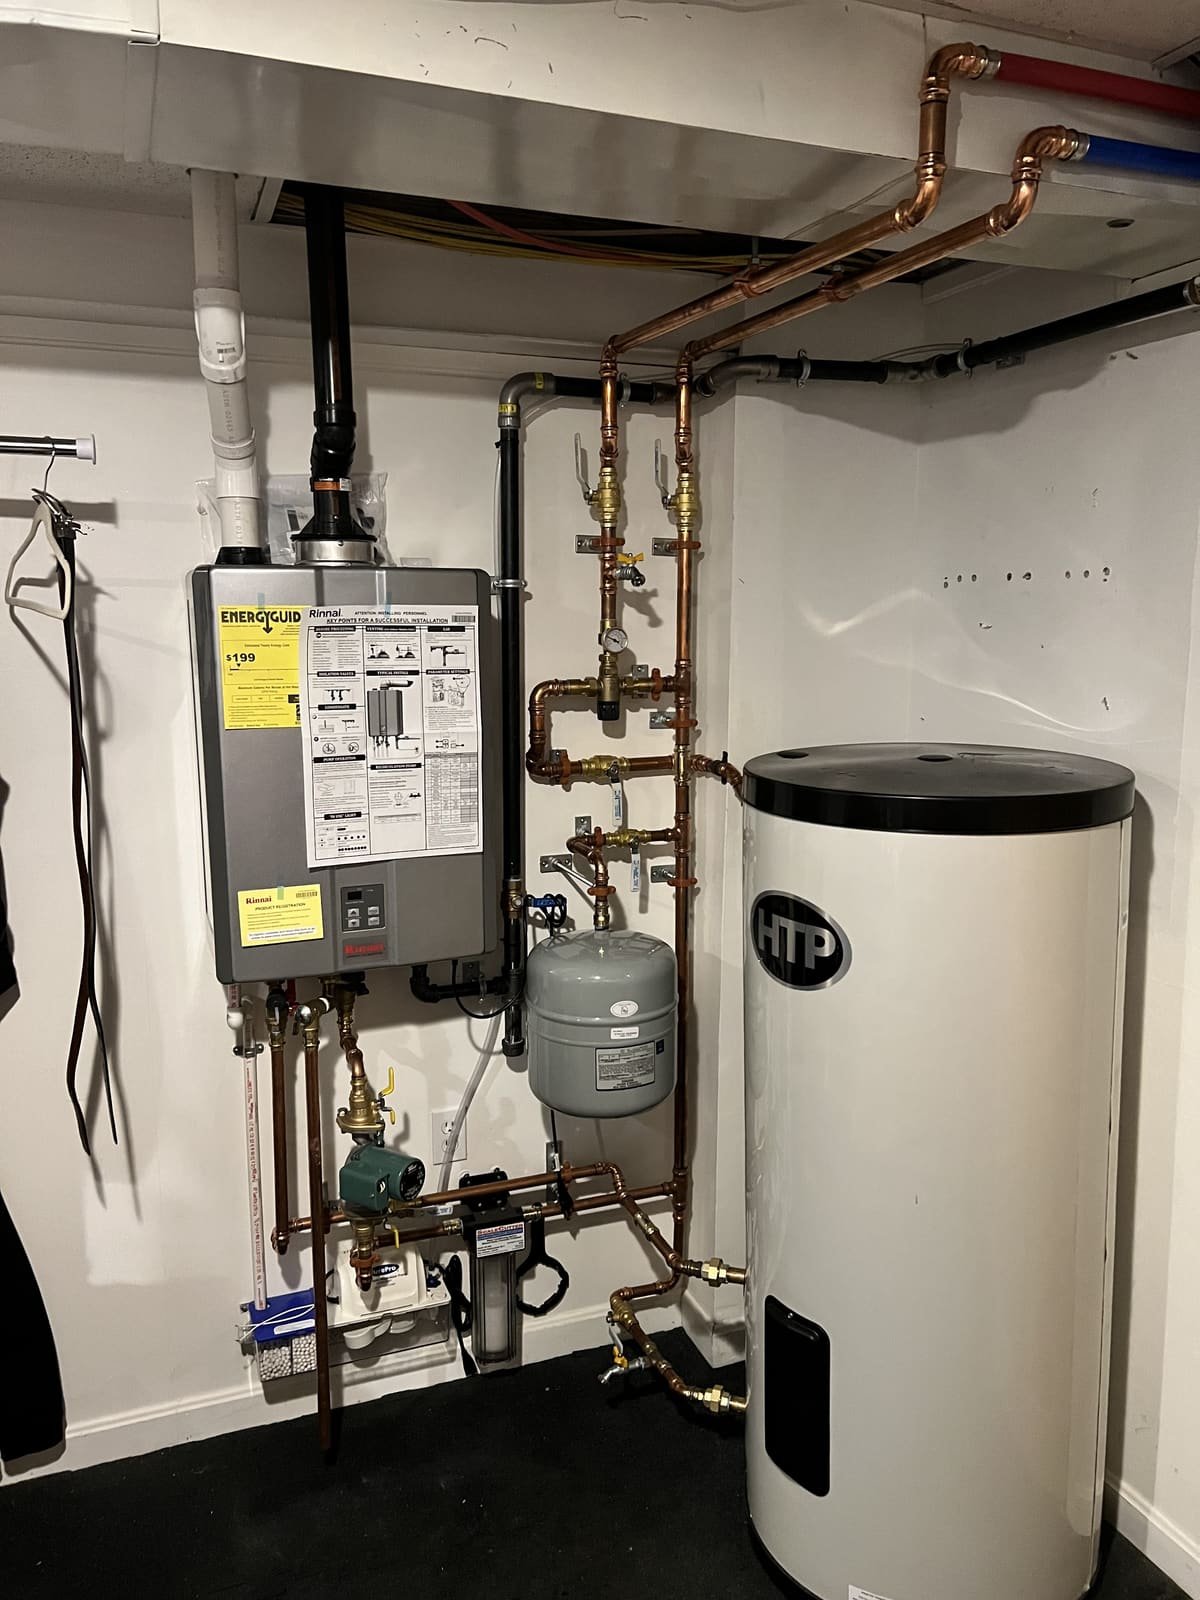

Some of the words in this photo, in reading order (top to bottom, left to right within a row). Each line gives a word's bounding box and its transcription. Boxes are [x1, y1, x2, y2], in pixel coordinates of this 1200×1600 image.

[309, 608, 342, 618] Rinnai
[226, 653, 256, 662] $199
[245, 896, 272, 904] Rinnai
[758, 907, 837, 970] HTP
